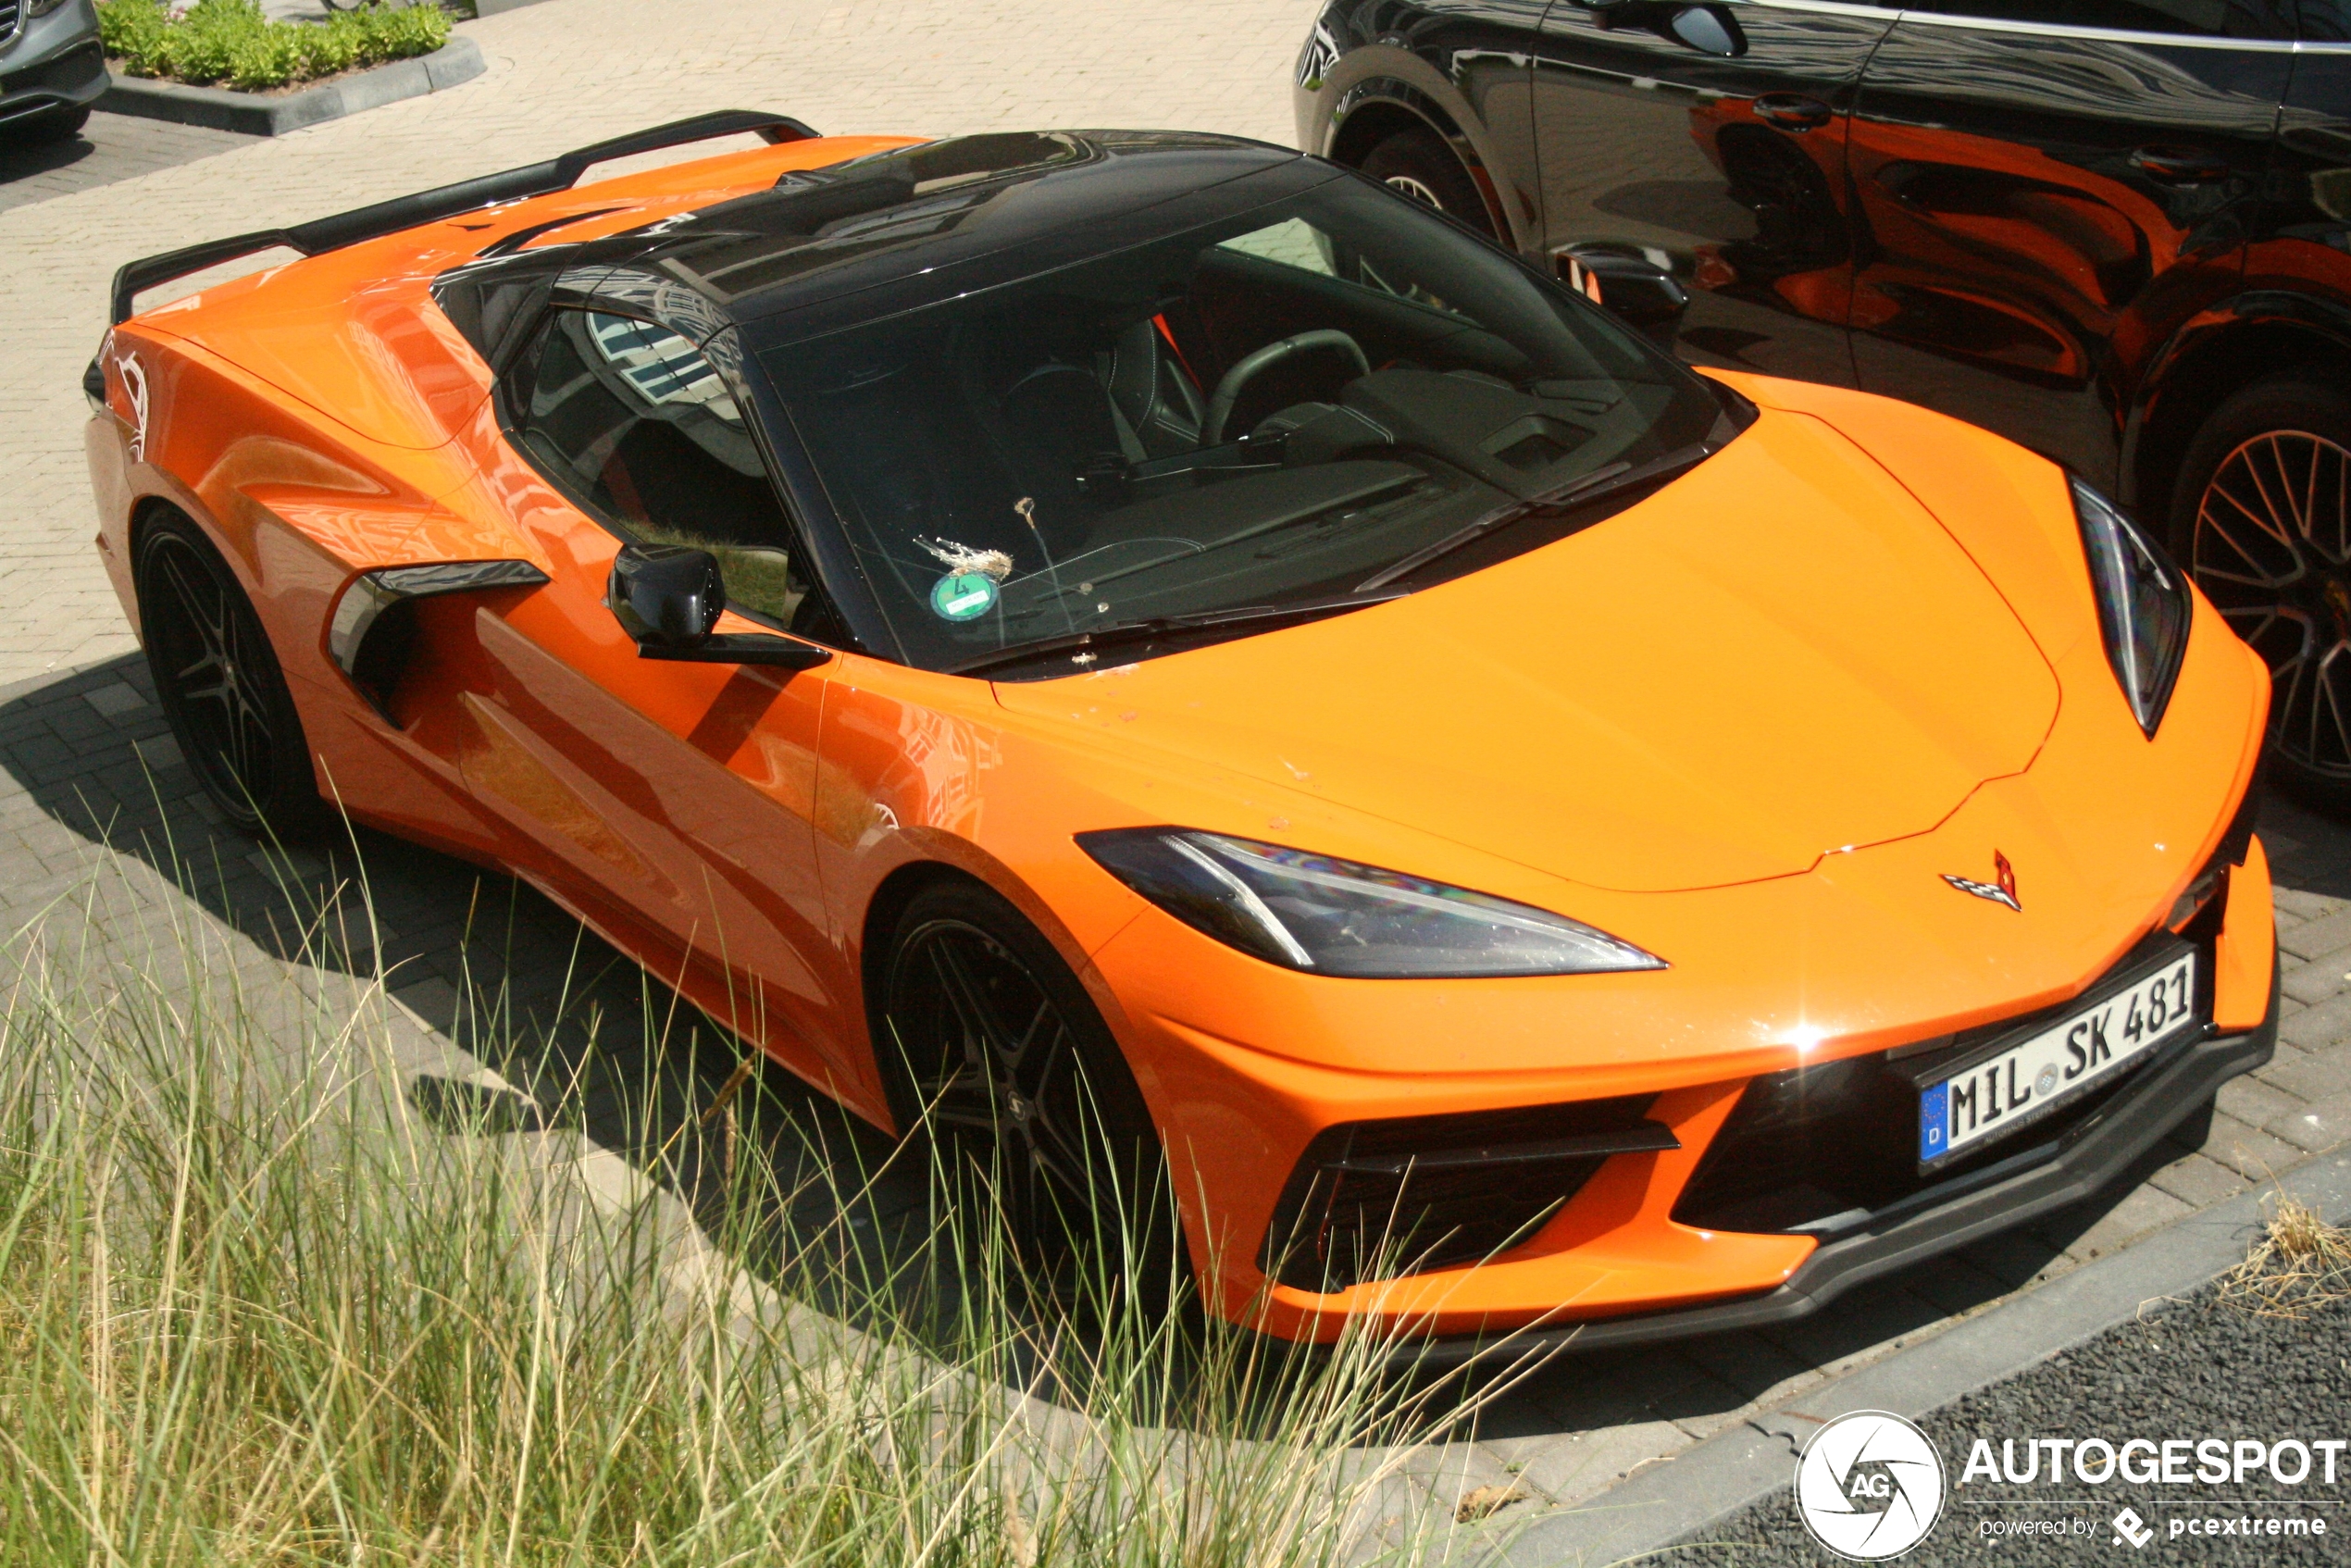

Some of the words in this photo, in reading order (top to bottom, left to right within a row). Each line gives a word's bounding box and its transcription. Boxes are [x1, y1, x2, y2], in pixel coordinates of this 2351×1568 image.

[954, 577, 970, 595] 4
[1951, 1057, 2031, 1139] MIL
[2064, 1006, 2112, 1080] SK
[2123, 964, 2188, 1043] 481
[1928, 1127, 1939, 1145] D
